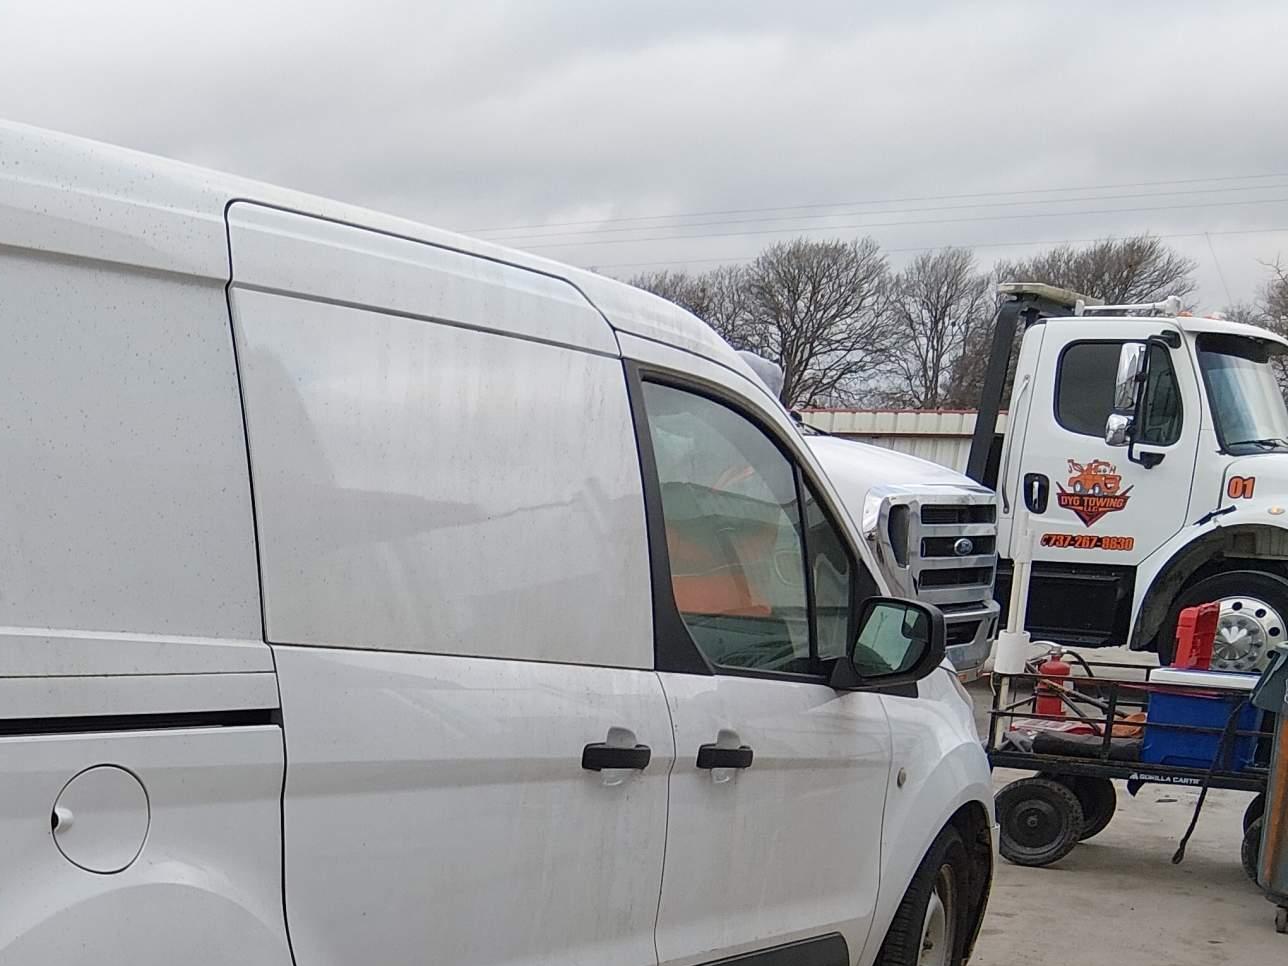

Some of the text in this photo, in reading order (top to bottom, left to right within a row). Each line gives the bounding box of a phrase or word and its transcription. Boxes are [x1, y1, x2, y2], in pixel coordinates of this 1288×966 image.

[1228, 476, 1255, 498] 01
[1083, 496, 1124, 508] TOWING
[1139, 773, 1171, 782] GORILLA
